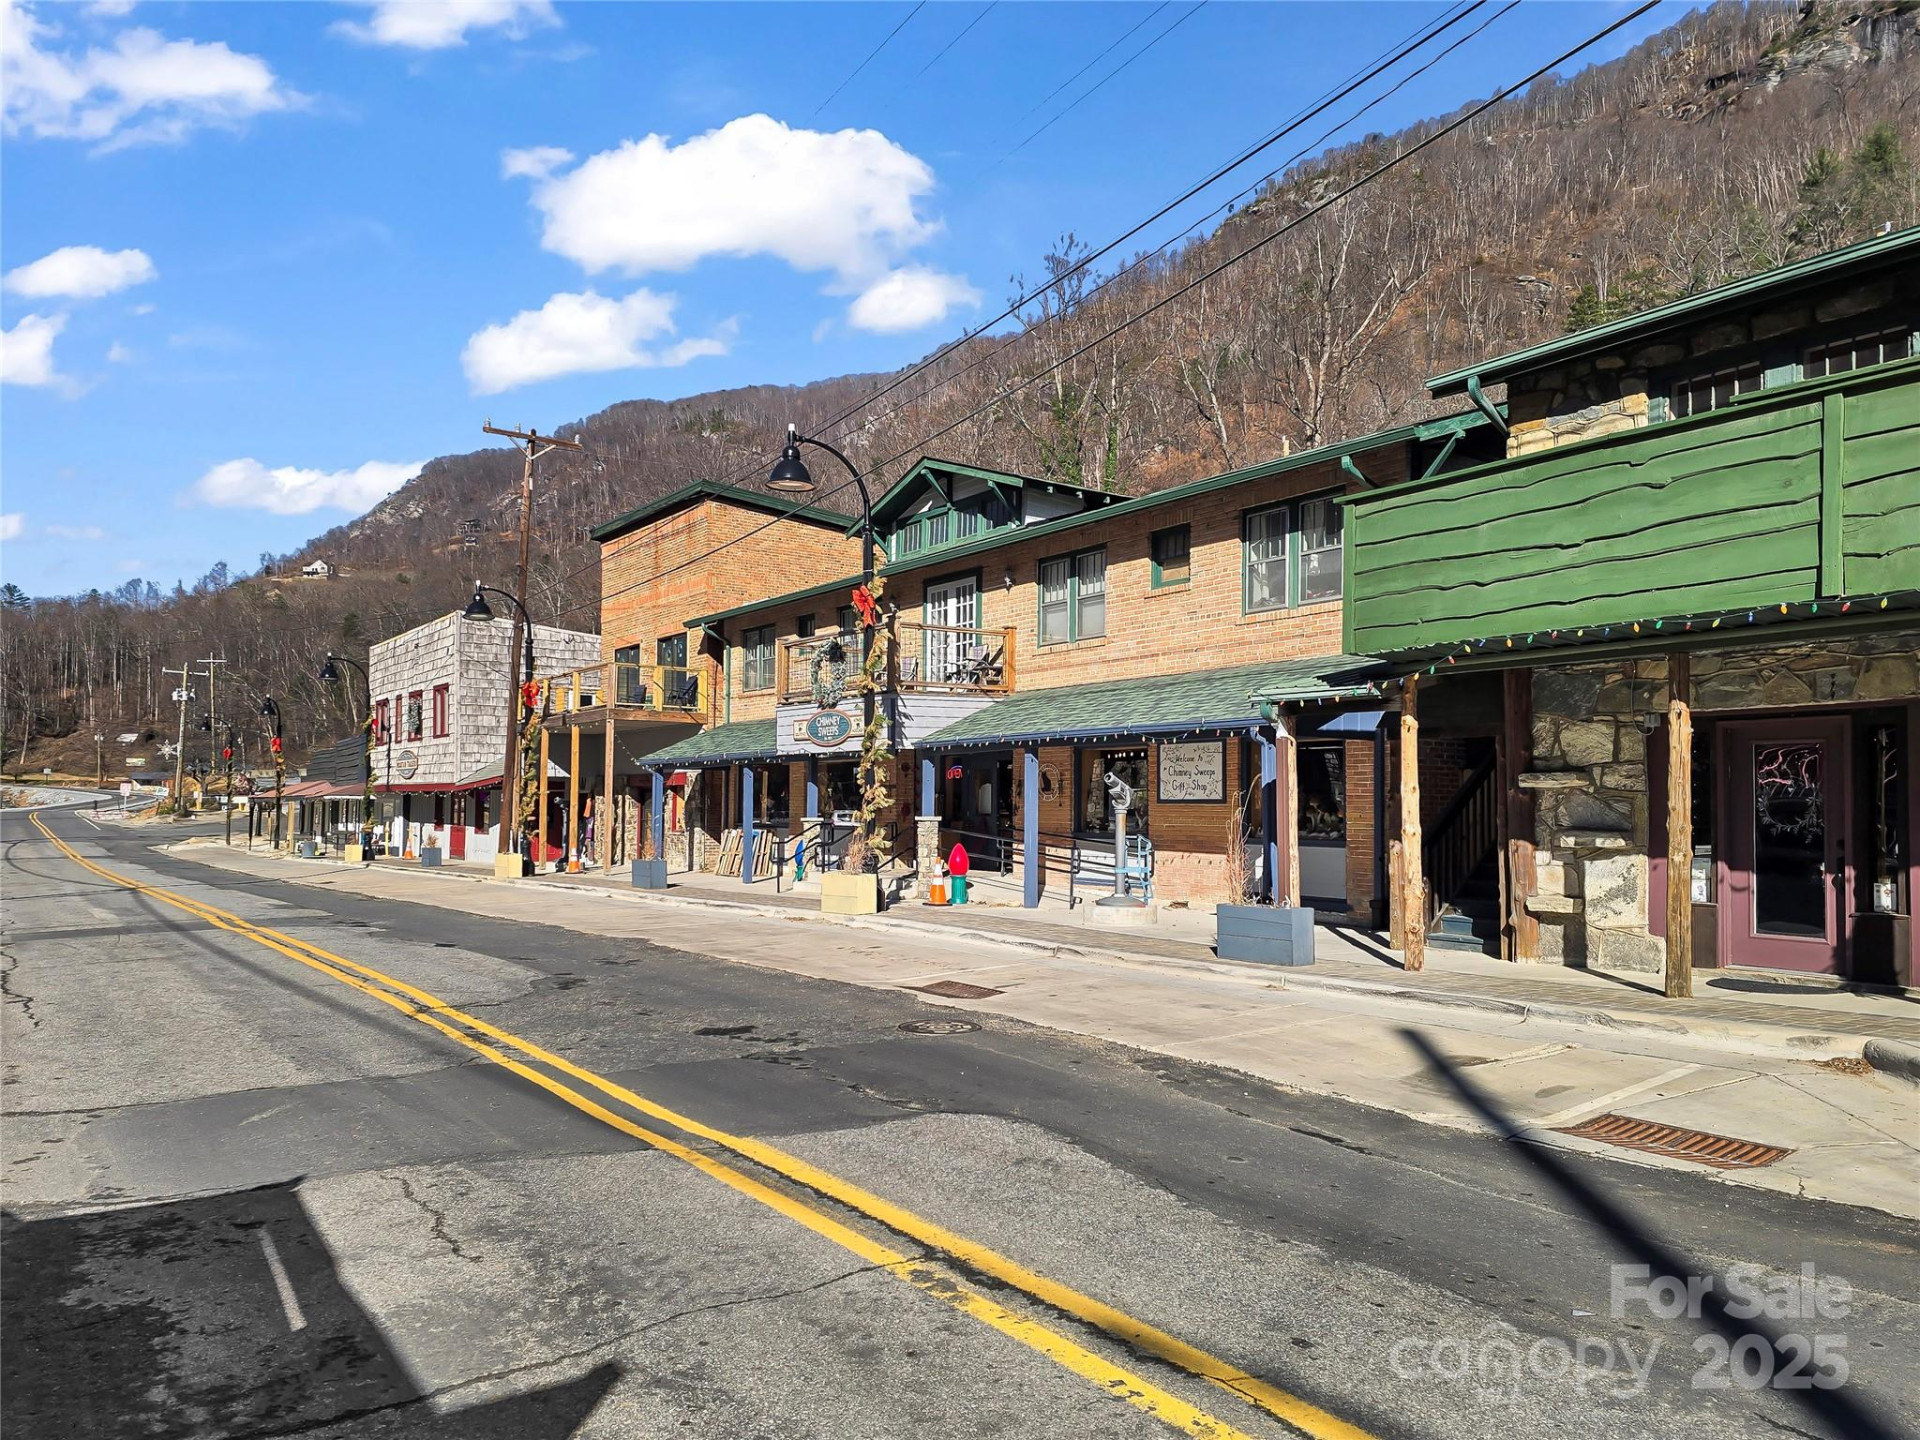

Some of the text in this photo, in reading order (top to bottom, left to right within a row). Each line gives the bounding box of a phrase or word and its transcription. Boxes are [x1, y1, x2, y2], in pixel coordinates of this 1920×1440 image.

[816, 715, 841, 727] CHIMNEY
[817, 726, 839, 736] SWEEPS
[1175, 753, 1203, 762] Welcome to
[1168, 765, 1216, 779] Chimney Sweeps
[1172, 779, 1207, 794] Gift Shop
